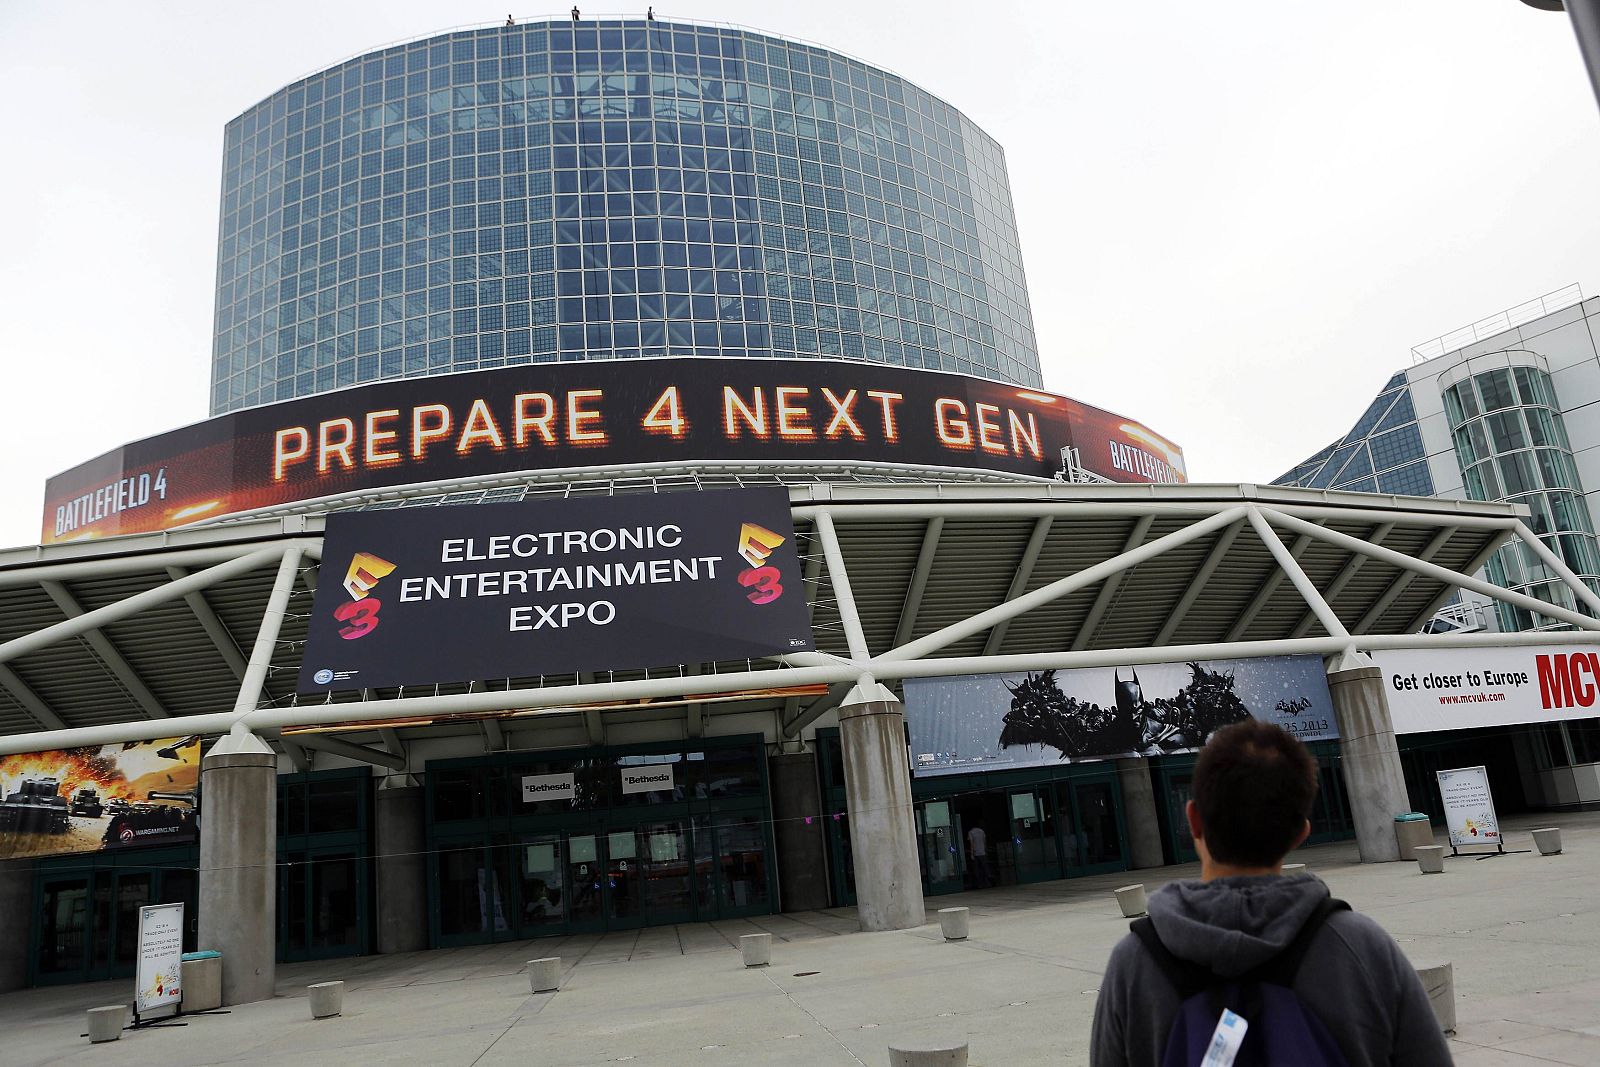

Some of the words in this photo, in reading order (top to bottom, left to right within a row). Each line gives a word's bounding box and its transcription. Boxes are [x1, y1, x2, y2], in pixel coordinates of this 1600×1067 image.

[274, 389, 606, 480] PREPARE
[643, 386, 685, 435] 4
[723, 386, 903, 440] NEXT
[935, 397, 1041, 458] GEN
[1109, 439, 1172, 483] BATTLEFIELD
[55, 473, 151, 537] BATTLEFIELD
[153, 468, 167, 499] 4
[441, 524, 682, 563] ELECTRONIC
[399, 556, 723, 603] ENTERTAINMENT
[509, 600, 616, 631] EXPO
[1392, 673, 1418, 691] Get
[1422, 672, 1462, 690] closer
[1466, 671, 1481, 687] to
[1483, 670, 1529, 687] Europe
[1438, 692, 1506, 705] www.mcvuk.com
[529, 782, 571, 793] Bethesda
[628, 773, 670, 784] Bethesda
